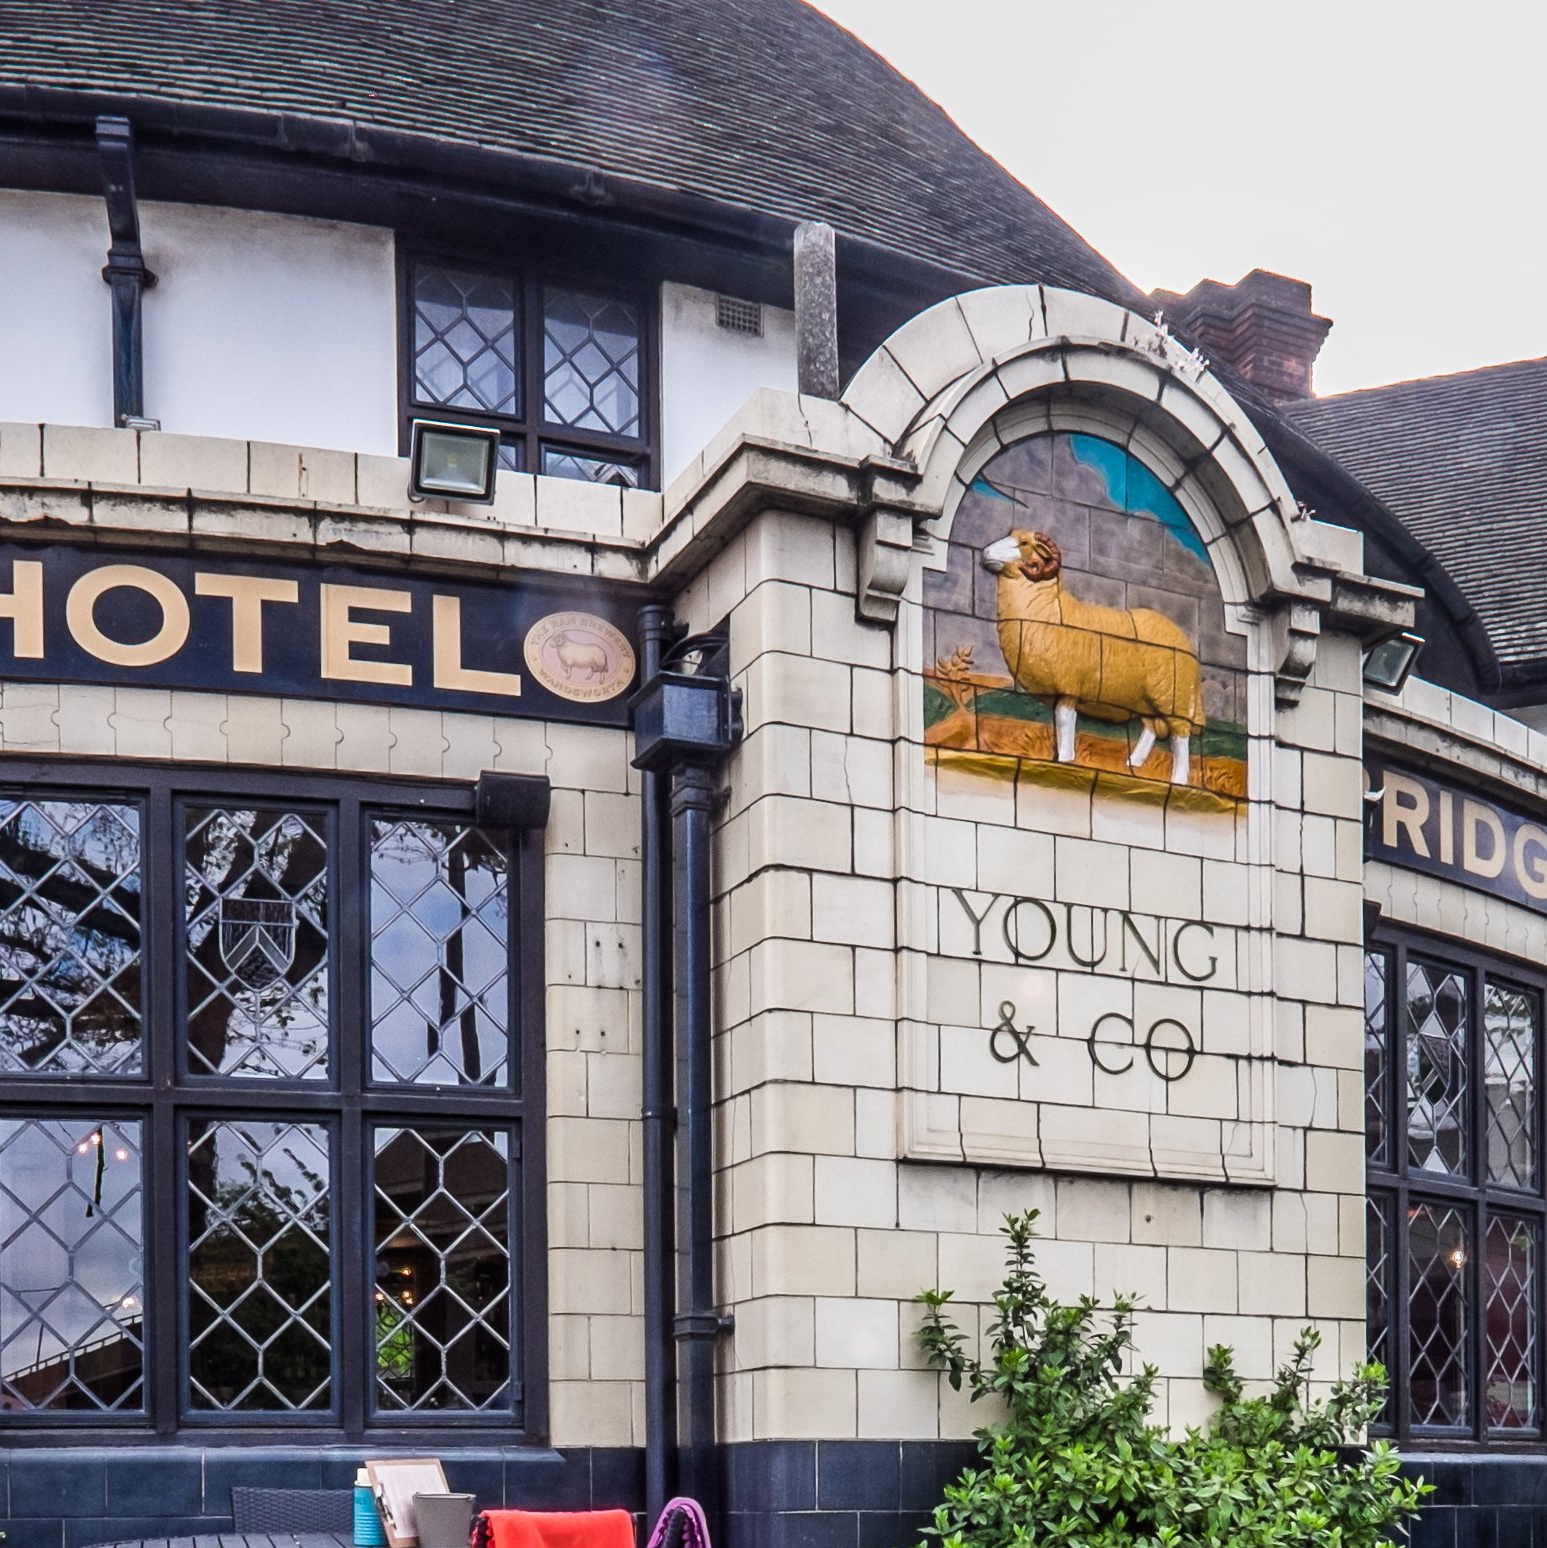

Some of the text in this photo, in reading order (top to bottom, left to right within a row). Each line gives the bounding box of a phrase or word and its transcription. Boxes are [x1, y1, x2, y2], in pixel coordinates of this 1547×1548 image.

[950, 886, 1220, 983] YOUNG
[988, 999, 1197, 1082] & CO
